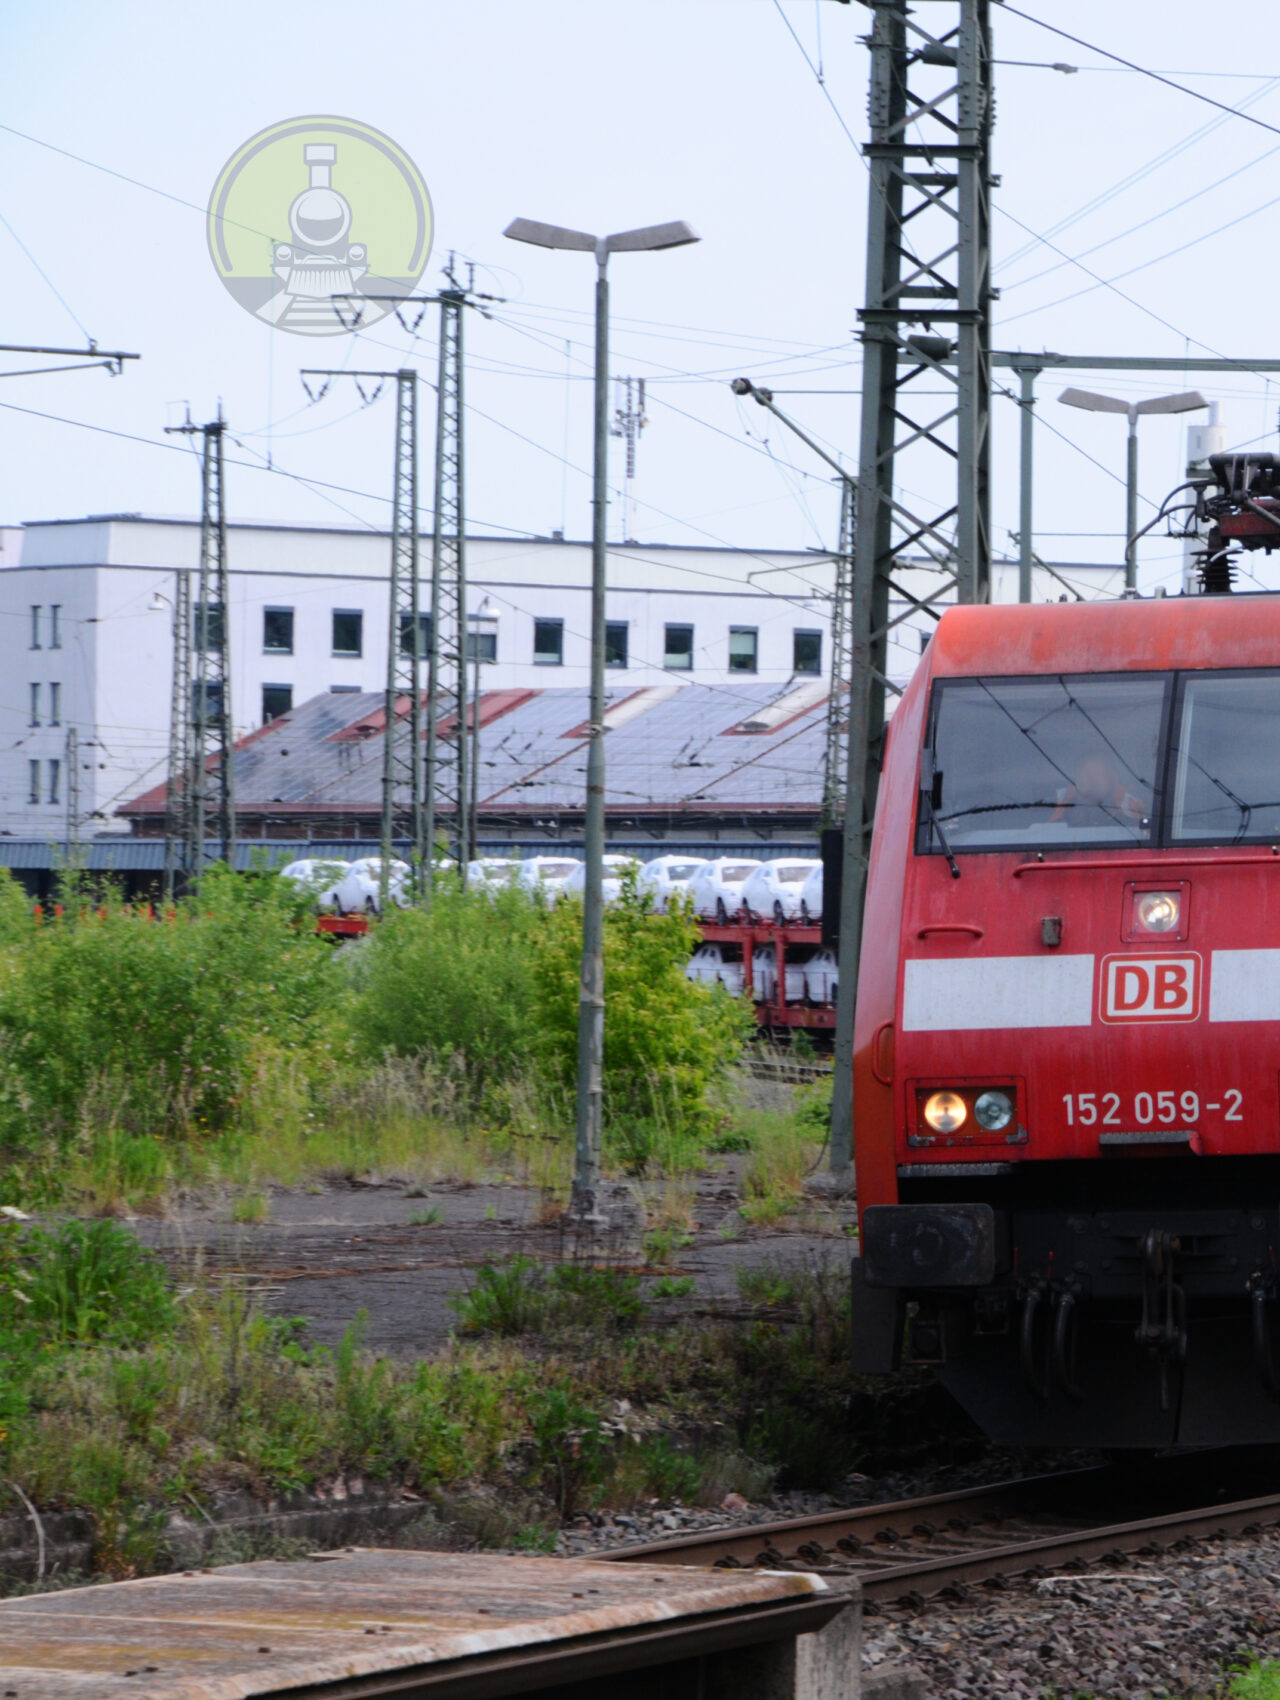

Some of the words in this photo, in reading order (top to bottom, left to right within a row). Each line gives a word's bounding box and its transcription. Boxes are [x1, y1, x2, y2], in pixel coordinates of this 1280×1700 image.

[1114, 964, 1189, 1011] DB
[1062, 1092, 1121, 1126] 152
[1134, 1088, 1244, 1124] 059-2
